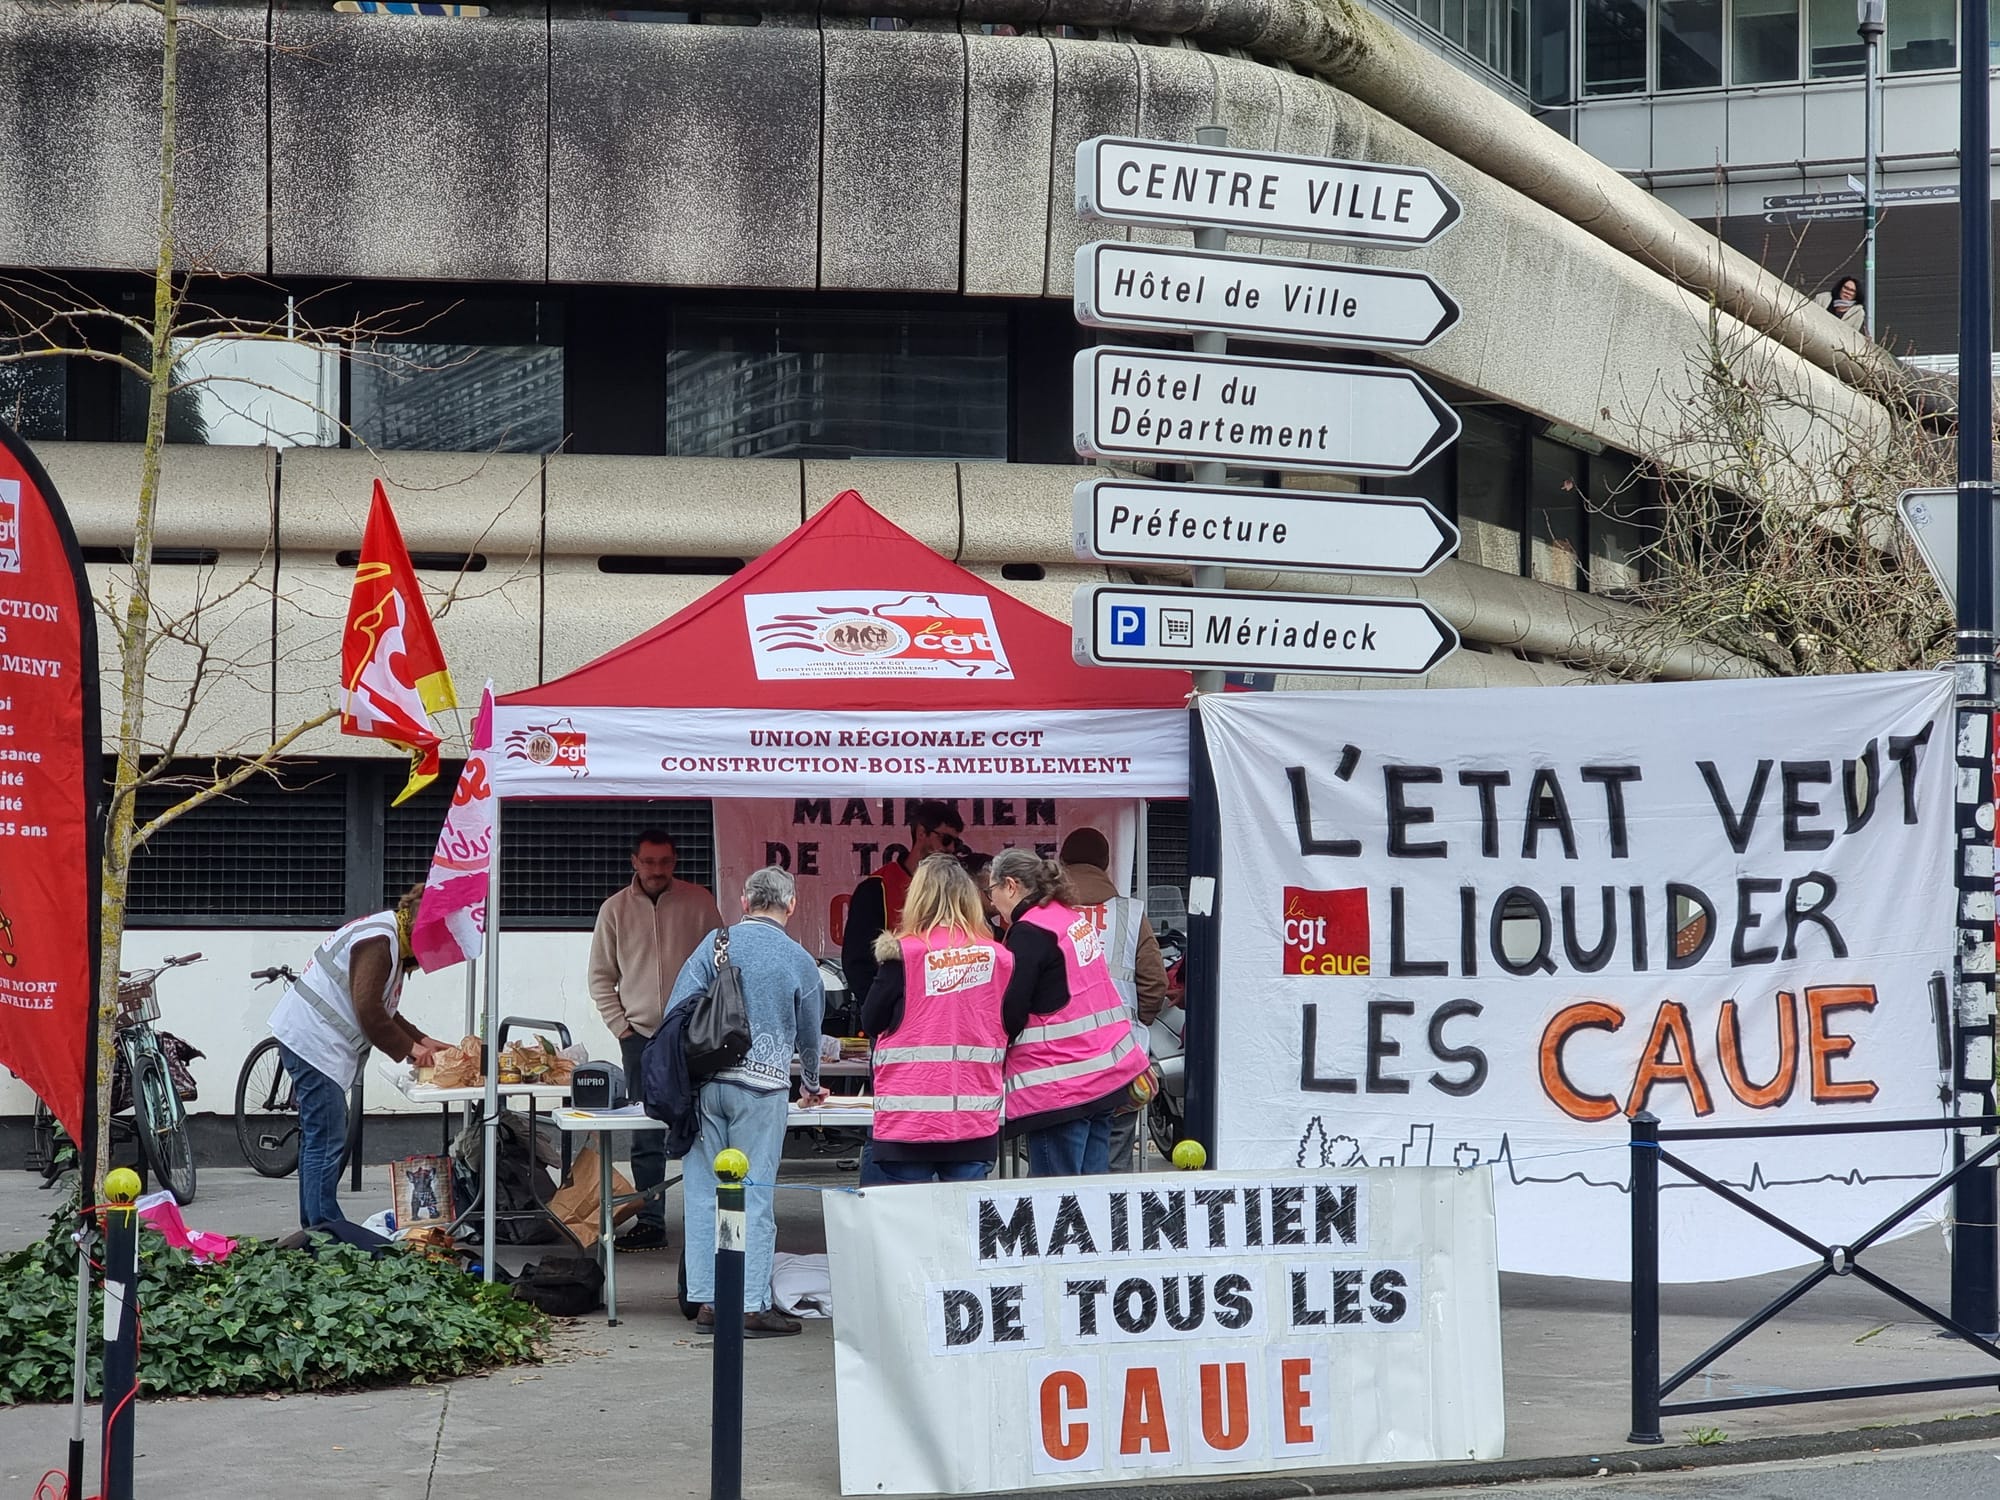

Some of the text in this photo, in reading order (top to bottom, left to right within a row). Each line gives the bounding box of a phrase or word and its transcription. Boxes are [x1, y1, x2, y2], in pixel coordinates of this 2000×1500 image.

[1118, 161, 1279, 209] CENTRE
[1308, 179, 1414, 223] VILLE
[1114, 268, 1358, 318] Hôtel de Ville
[1111, 367, 1257, 406] Hôtel du
[1111, 406, 1329, 450] Département
[1110, 505, 1288, 544] Préfecture
[914, 632, 992, 655] cgt
[916, 622, 956, 636] la
[1206, 615, 1377, 651] Mériadeck
[558, 743, 587, 761] cgt
[749, 727, 1044, 748] UNION RÉGIONALE CGT
[0, 771, 24, 786] ité
[660, 756, 1131, 774] CONSTRUCTION-BOIS-AMEUBLEMENT
[1285, 744, 1643, 860] L'ETAT
[1695, 720, 1934, 854] VEUT
[792, 797, 1058, 825] MAIIEN
[21, 824, 48, 837] ans
[765, 842, 819, 876] DE
[1285, 896, 1315, 918] la
[1284, 916, 1327, 953] cgt
[1389, 871, 1848, 976] LIQUIDER
[928, 951, 991, 971] Solidaires
[948, 963, 990, 977] Finances
[12, 980, 58, 993] MORT
[932, 974, 978, 990] Publiques
[1300, 999, 1489, 1097] LES
[1538, 984, 1879, 1122] CAUE
[576, 1076, 606, 1087] MIPRO
[977, 1182, 1359, 1263] MAINTIEN
[937, 1268, 1409, 1350] DE TOUS LES
[1038, 1357, 1314, 1462] CAUE
